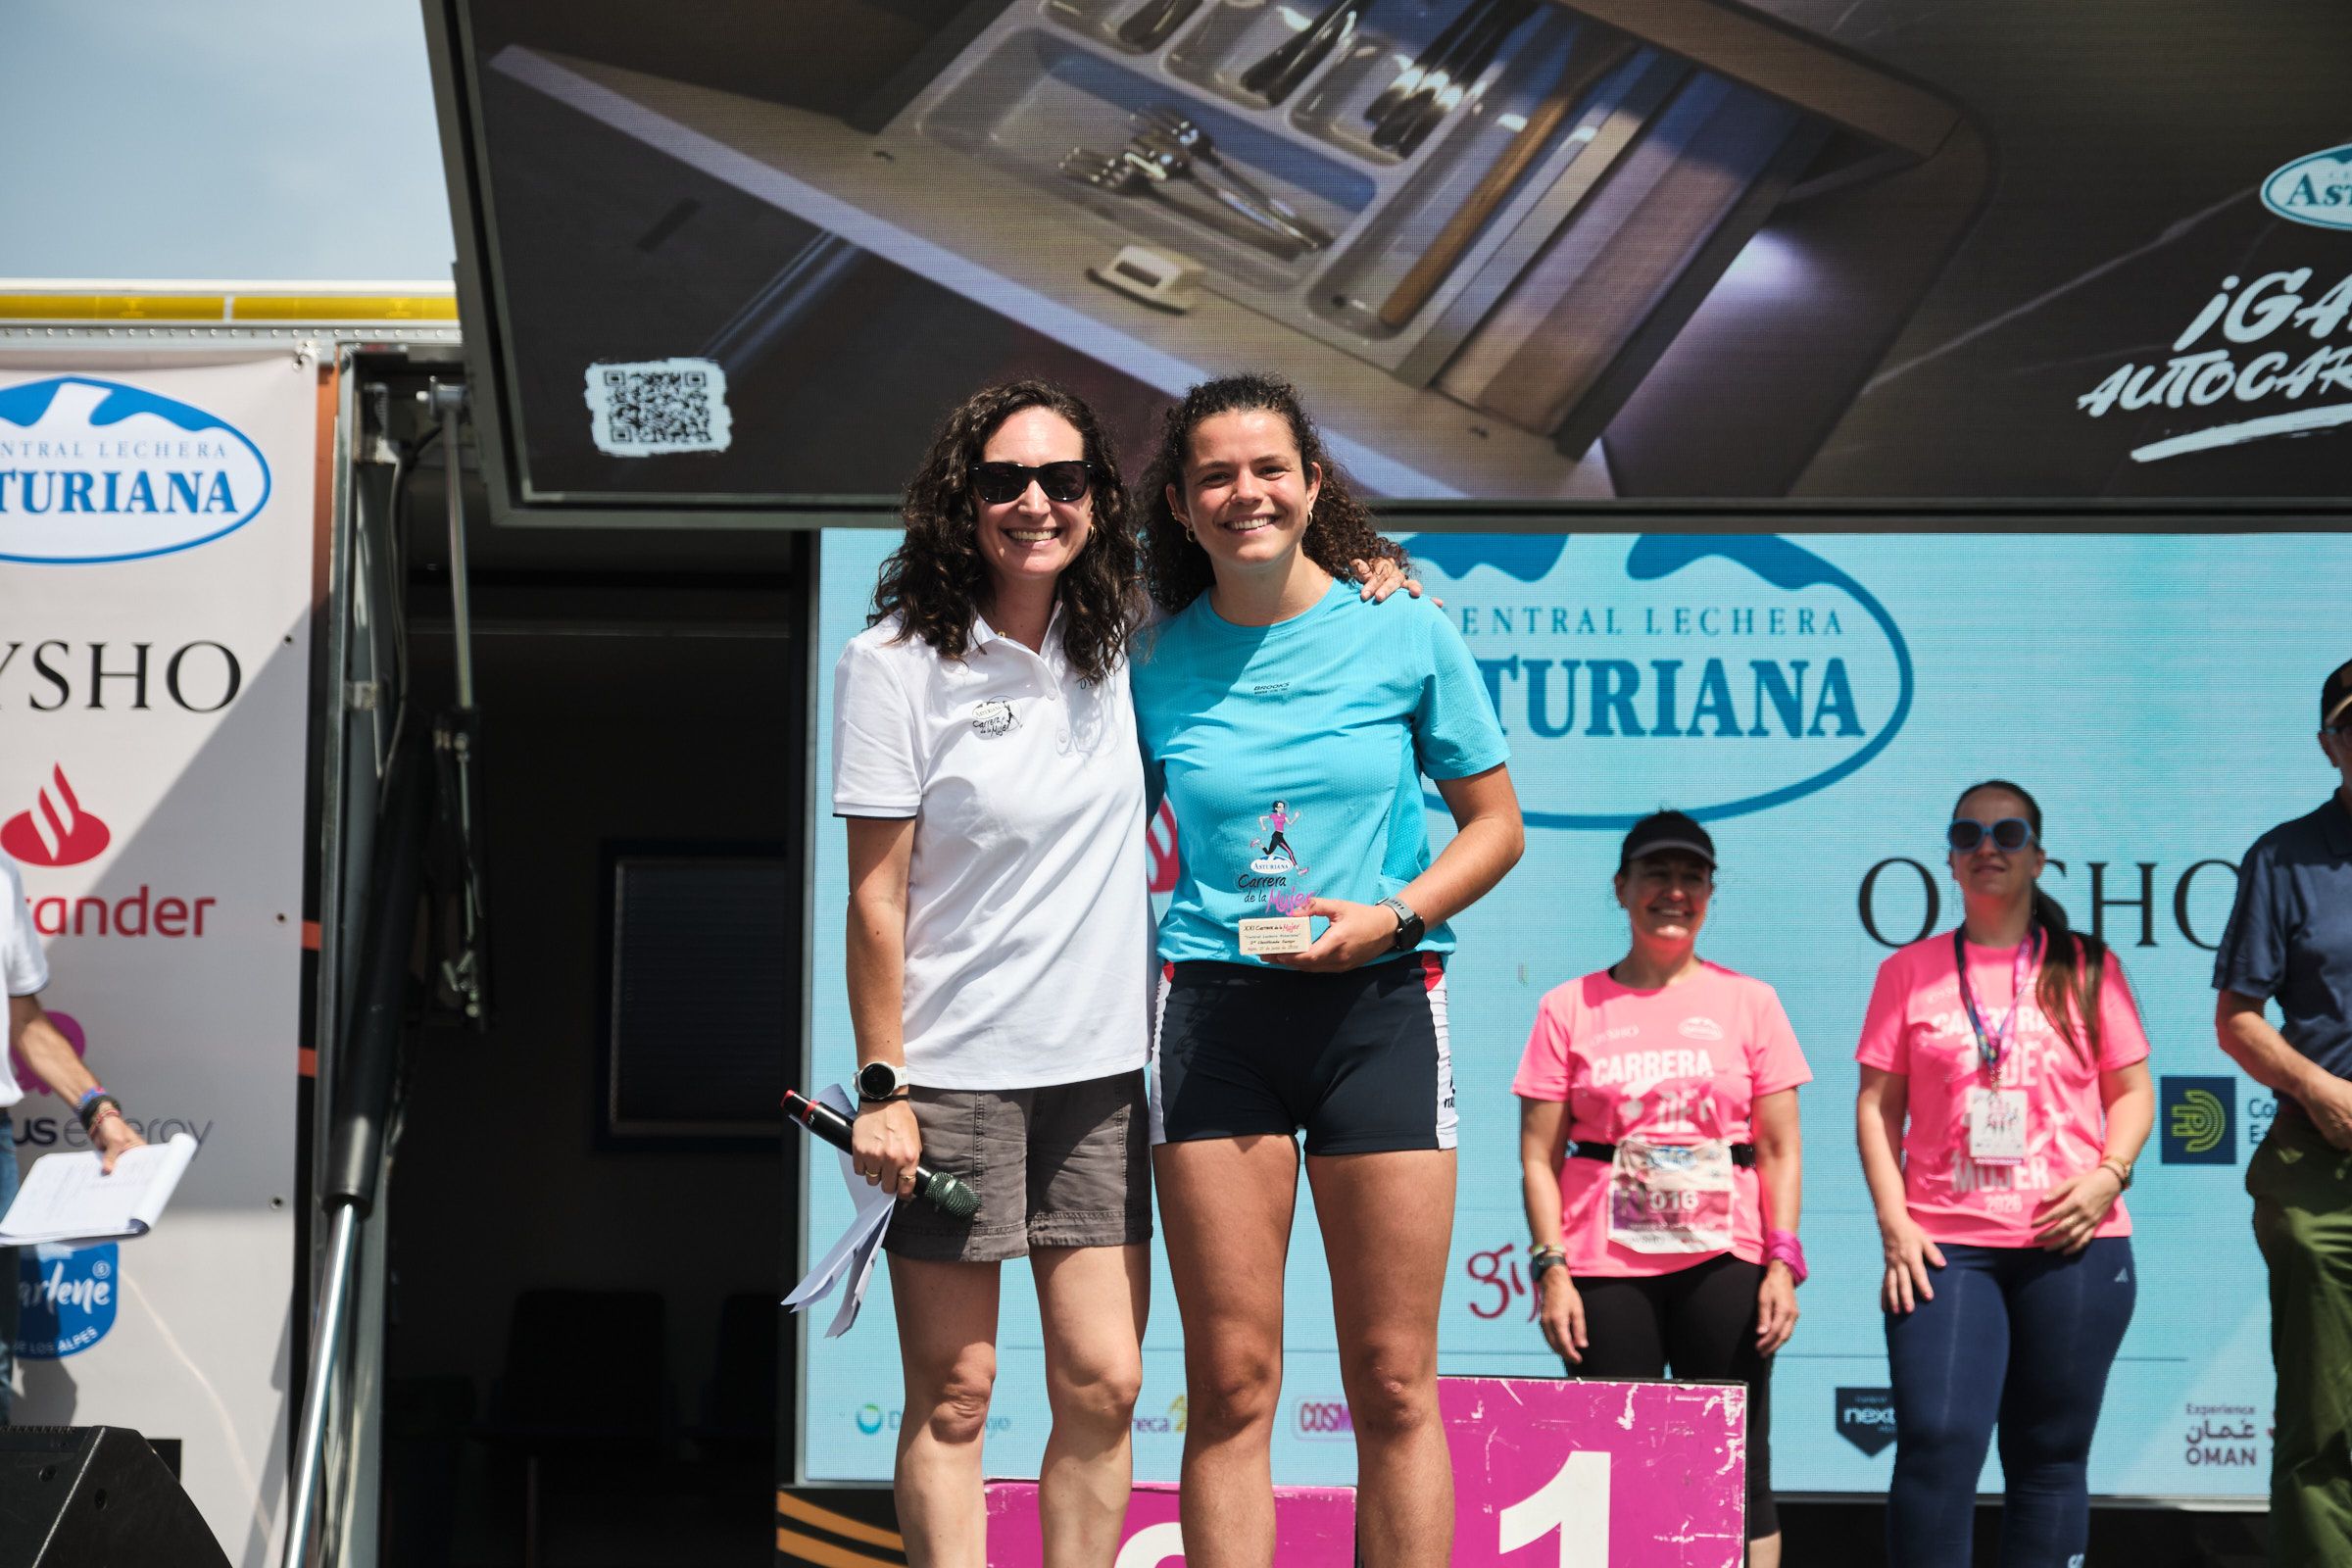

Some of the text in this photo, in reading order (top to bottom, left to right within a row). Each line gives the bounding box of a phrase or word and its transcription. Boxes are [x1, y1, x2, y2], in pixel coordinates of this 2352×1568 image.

[99, 442, 226, 458] LECHERA
[1441, 605, 1842, 636] ENTRAL LECHERA
[1238, 874, 1287, 889] Carrera
[1244, 890, 1256, 904] de
[1258, 890, 1267, 903] la
[26, 884, 217, 938] ander
[1590, 1048, 1714, 1087] CARRERA
[1951, 1151, 2050, 1193] MUJER
[57, 1326, 99, 1353] ALPES
[2185, 1402, 2256, 1417] Experience
[2185, 1447, 2257, 1466] OMAN
[1498, 1449, 1612, 1568] 1
